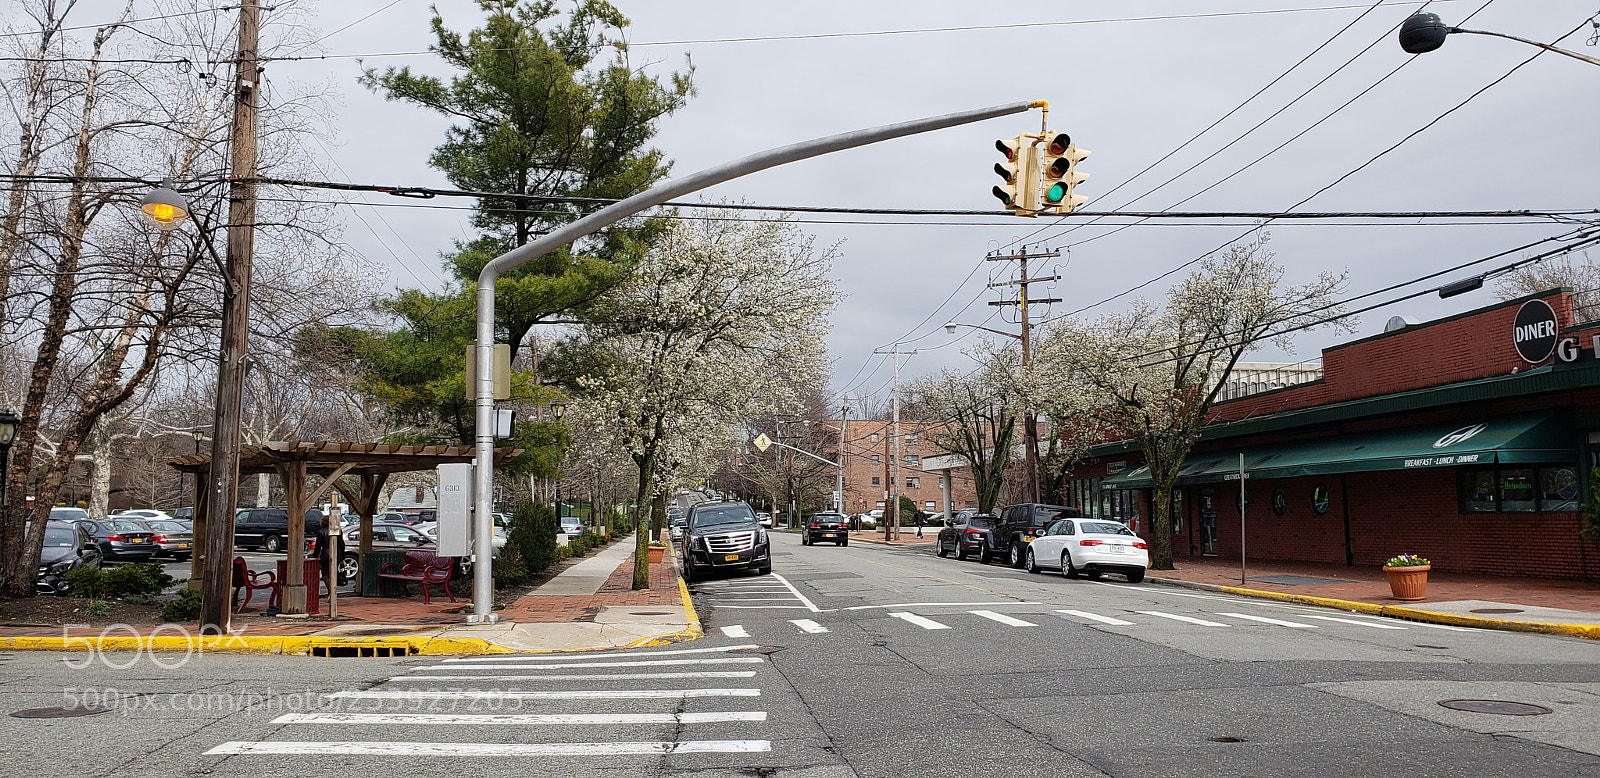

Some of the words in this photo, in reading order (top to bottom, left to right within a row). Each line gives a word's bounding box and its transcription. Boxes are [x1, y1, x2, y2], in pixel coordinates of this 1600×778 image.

[1516, 320, 1556, 343] DINER
[1404, 458, 1433, 468] BREAKFAST
[1504, 481, 1532, 490] Heineken
